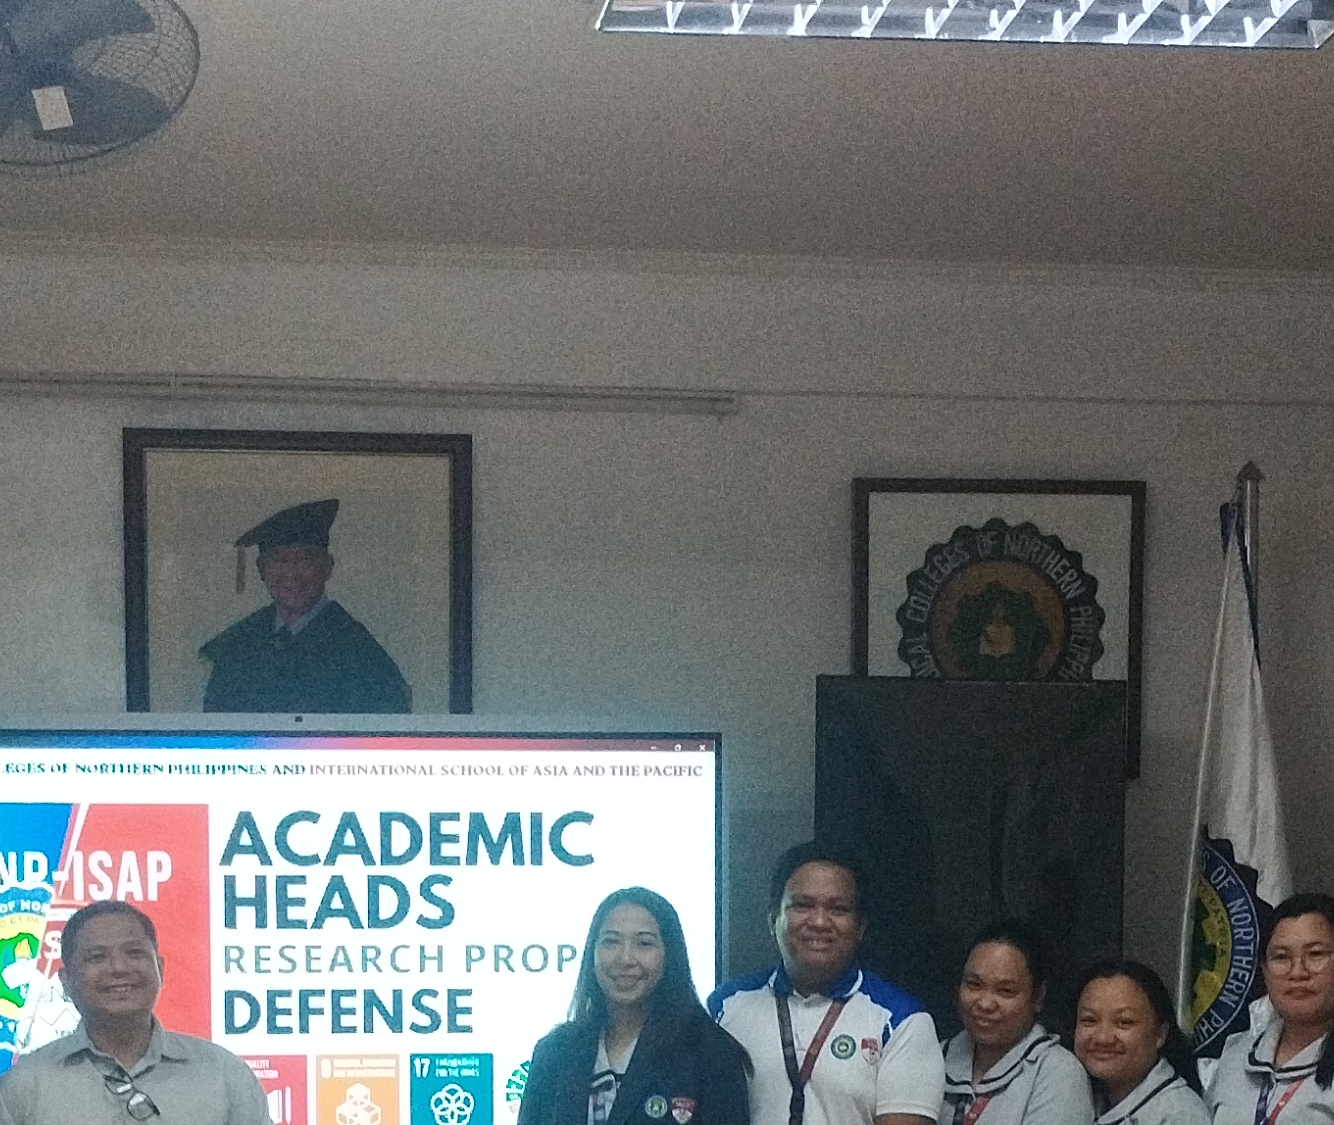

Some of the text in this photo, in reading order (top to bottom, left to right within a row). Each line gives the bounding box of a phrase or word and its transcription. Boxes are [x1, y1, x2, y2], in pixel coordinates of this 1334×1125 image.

[905, 541, 972, 623] COLLEGES
[975, 530, 997, 558] OF
[1003, 531, 1087, 601] NORTHERN
[1057, 604, 1094, 681] PHILIPPI
[51, 763, 68, 775] OF
[75, 763, 164, 775] NORTHERN
[168, 764, 267, 775] PHILIPPINES
[272, 764, 305, 776] AND
[309, 764, 436, 776] INTERNATIONAL
[441, 765, 505, 777] SCHOOL
[509, 765, 529, 777] OF
[533, 765, 568, 777] ASIA
[573, 765, 605, 777] AND
[609, 765, 640, 777] THE
[643, 765, 704, 778] PACIFIC
[219, 811, 594, 866] ACADEMIC
[1210, 865, 1237, 892] OF
[224, 874, 455, 929] HEADS
[225, 945, 576, 973] RESEARCH PROP
[1218, 897, 1255, 1010] NORTHERN
[225, 989, 473, 1034] DEFENSE
[413, 1057, 431, 1078] 17
